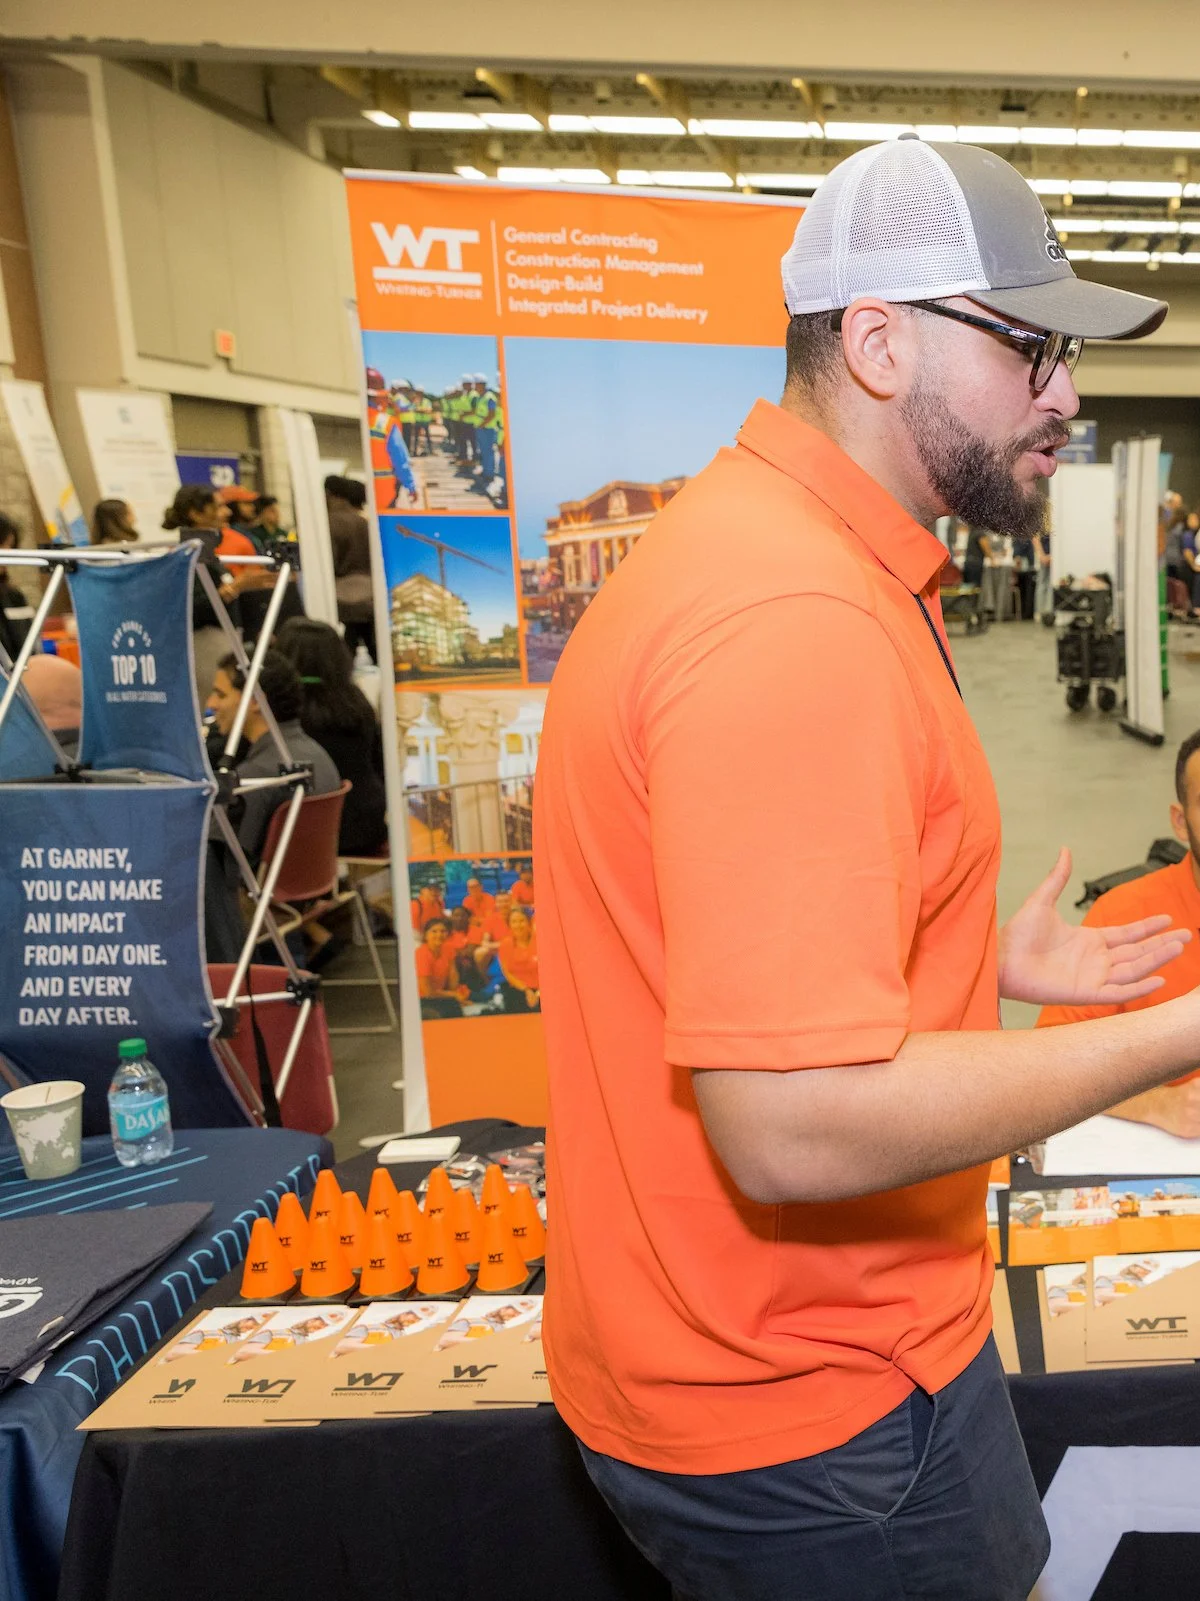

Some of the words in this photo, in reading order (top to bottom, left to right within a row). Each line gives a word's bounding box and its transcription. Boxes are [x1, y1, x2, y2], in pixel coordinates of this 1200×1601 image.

[370, 221, 480, 270] WT
[504, 226, 567, 246] General
[571, 228, 658, 254] Contracting
[505, 250, 600, 269] Construction
[605, 255, 704, 277] Management
[507, 273, 604, 294] Design-Build
[509, 296, 588, 317] Integrated
[592, 299, 643, 319] Project
[646, 302, 709, 324] Delivery
[111, 654, 138, 686] TOP
[139, 653, 157, 686] 10
[21, 847, 44, 869] AT
[49, 847, 132, 873] GARNEY,
[22, 880, 62, 901] YOU
[66, 880, 105, 901] CAN
[109, 879, 163, 900] MAKE
[24, 912, 51, 934] AN
[55, 912, 126, 933] IMPACT
[24, 945, 78, 966] FROM
[82, 944, 120, 965] DAY
[122, 944, 168, 966] ONE.
[20, 977, 64, 997] AND
[68, 976, 132, 997] EVERY
[19, 1007, 62, 1026] DAY
[66, 1006, 138, 1026] AFTER.
[1126, 1316, 1187, 1330] WT
